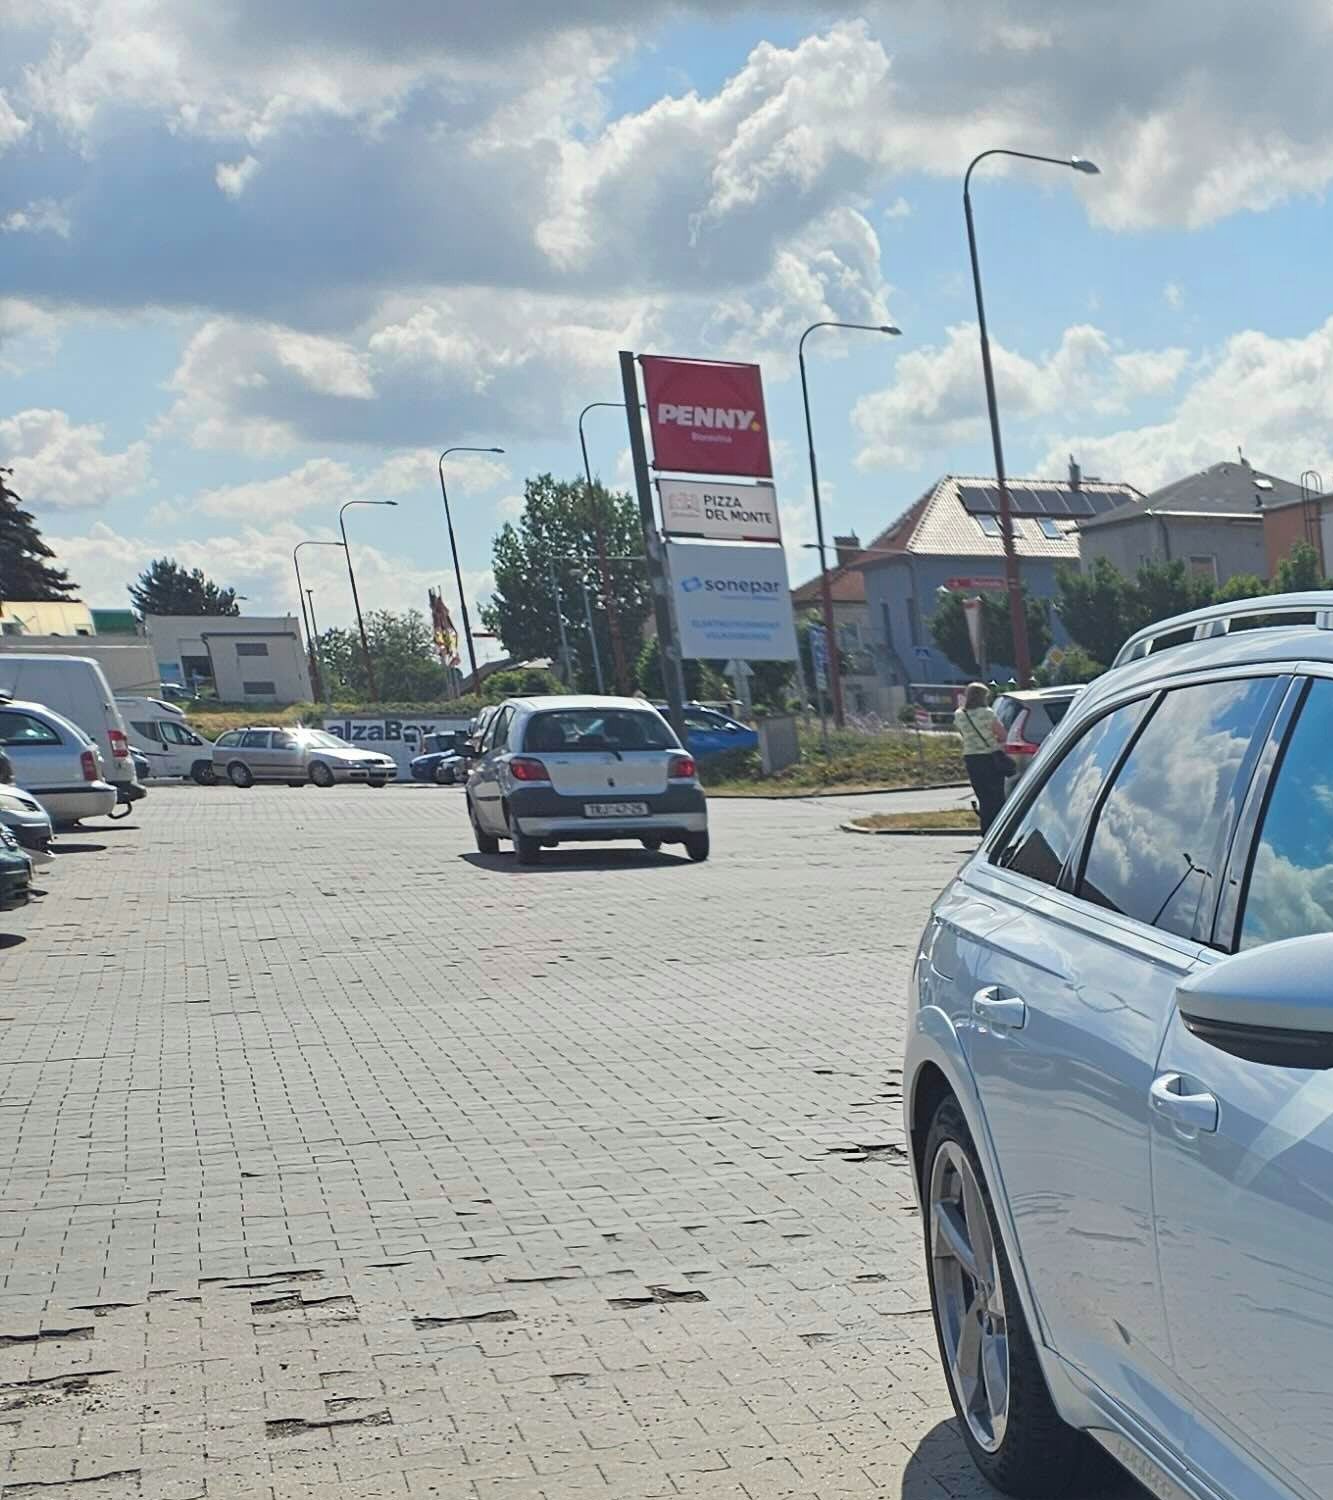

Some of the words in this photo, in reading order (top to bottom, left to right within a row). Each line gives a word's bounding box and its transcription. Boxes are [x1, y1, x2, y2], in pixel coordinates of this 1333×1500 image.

[704, 494, 742, 508] PIZZA
[706, 508, 728, 521] DEL
[731, 511, 773, 524] MONTE
[704, 580, 779, 594] sonepar
